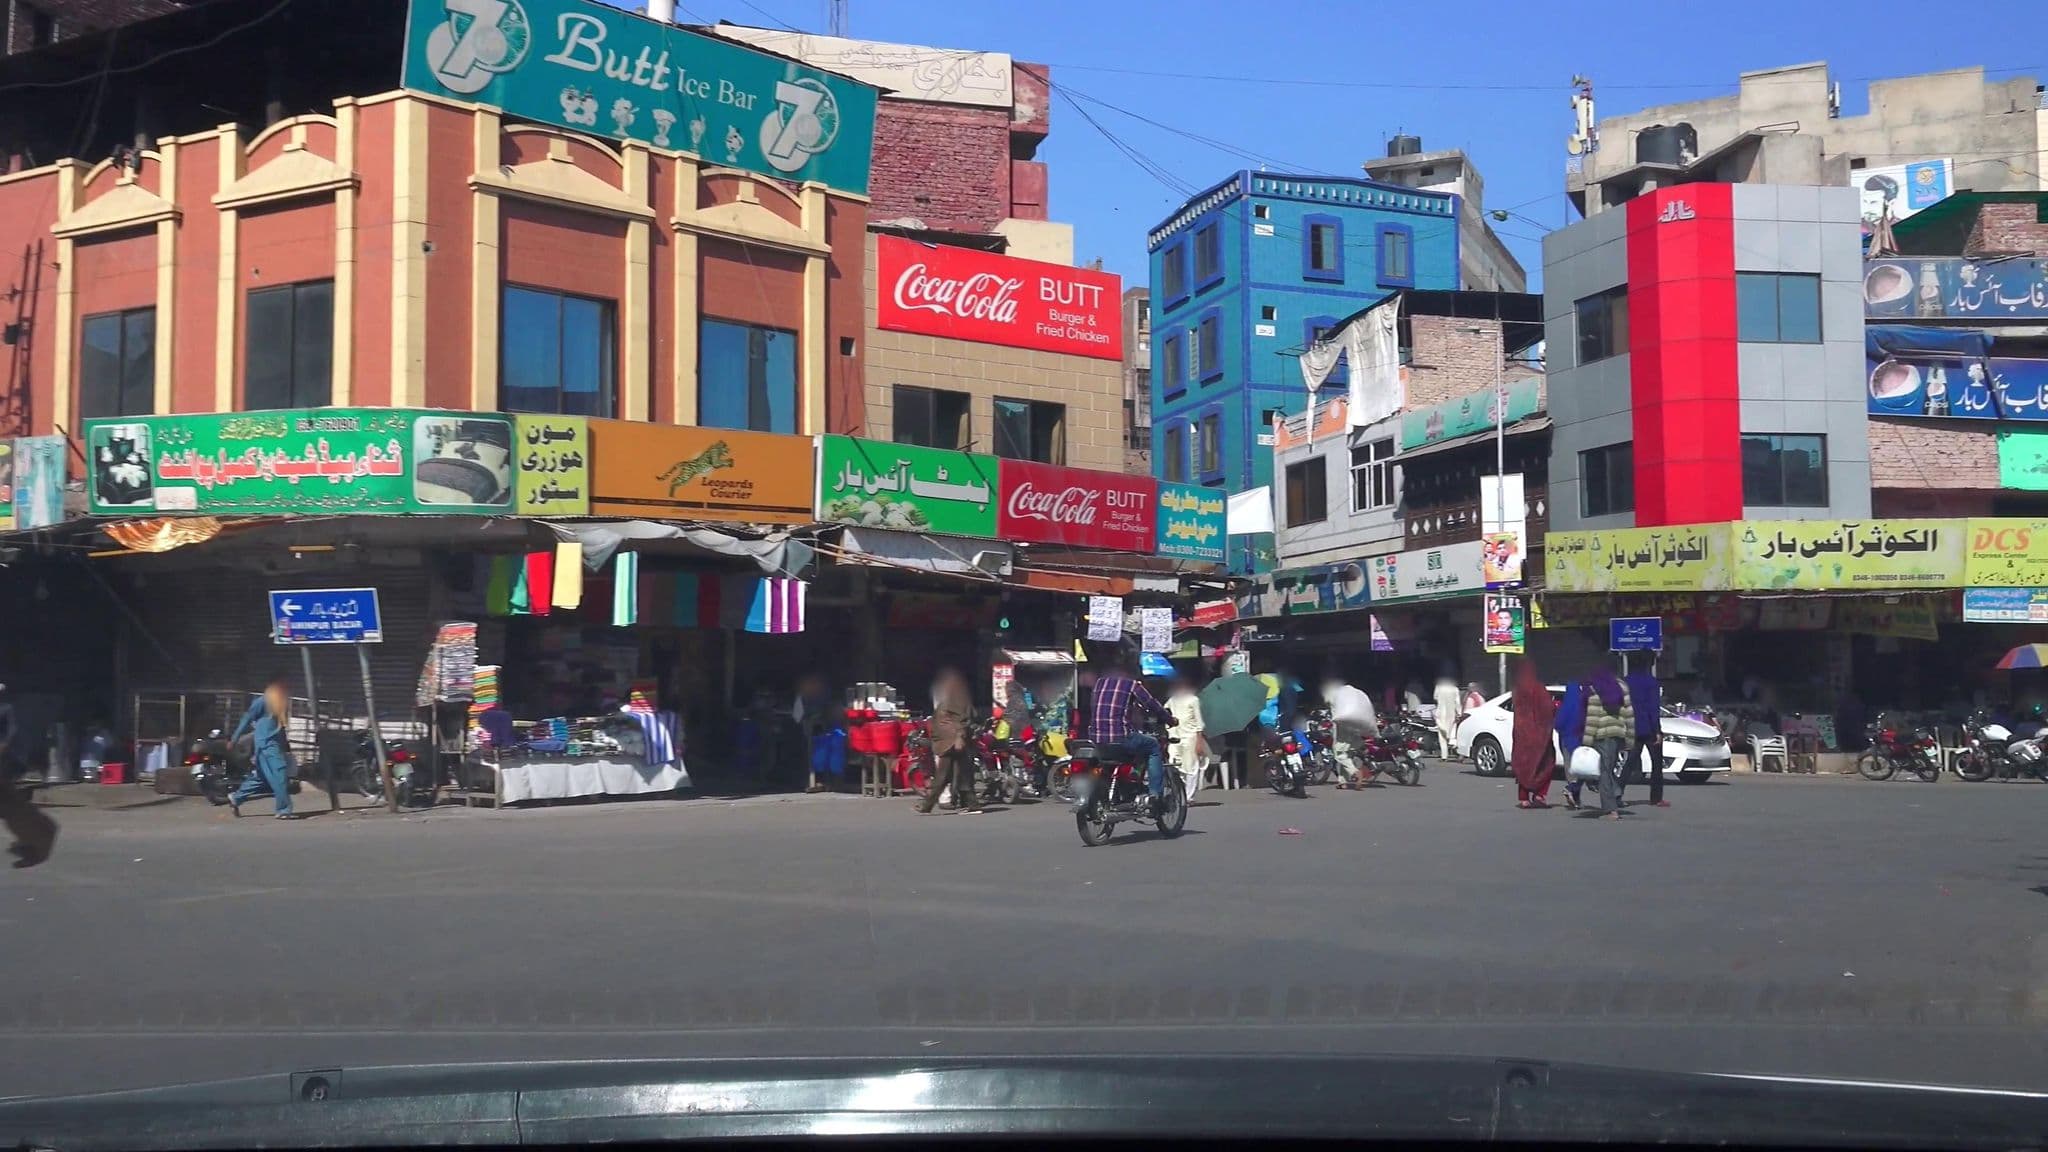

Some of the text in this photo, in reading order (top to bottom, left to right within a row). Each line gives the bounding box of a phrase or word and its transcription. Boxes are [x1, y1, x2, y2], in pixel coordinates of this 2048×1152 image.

[544, 12, 758, 110] Butt Ice Bar
[894, 263, 1025, 323] Coca-Cola
[1040, 276, 1104, 309] BUTT
[1049, 308, 1097, 326] Burger &
[1036, 322, 1110, 344] Fried Chicken
[701, 476, 753, 489] Leopards
[832, 459, 863, 493] بار
[711, 488, 752, 499] Courier
[1008, 482, 1101, 525] Coca-Cola
[1106, 489, 1148, 509] BUTT
[1102, 520, 1150, 533] Fried Chicken
[1111, 510, 1135, 522] Burger
[1606, 529, 1708, 569] الکوثر آئس بار
[1760, 523, 1938, 559] الکوثر آئس بار
[1973, 527, 2032, 551] DCS
[1973, 552, 2002, 560] Express
[2006, 559, 2015, 569] &
